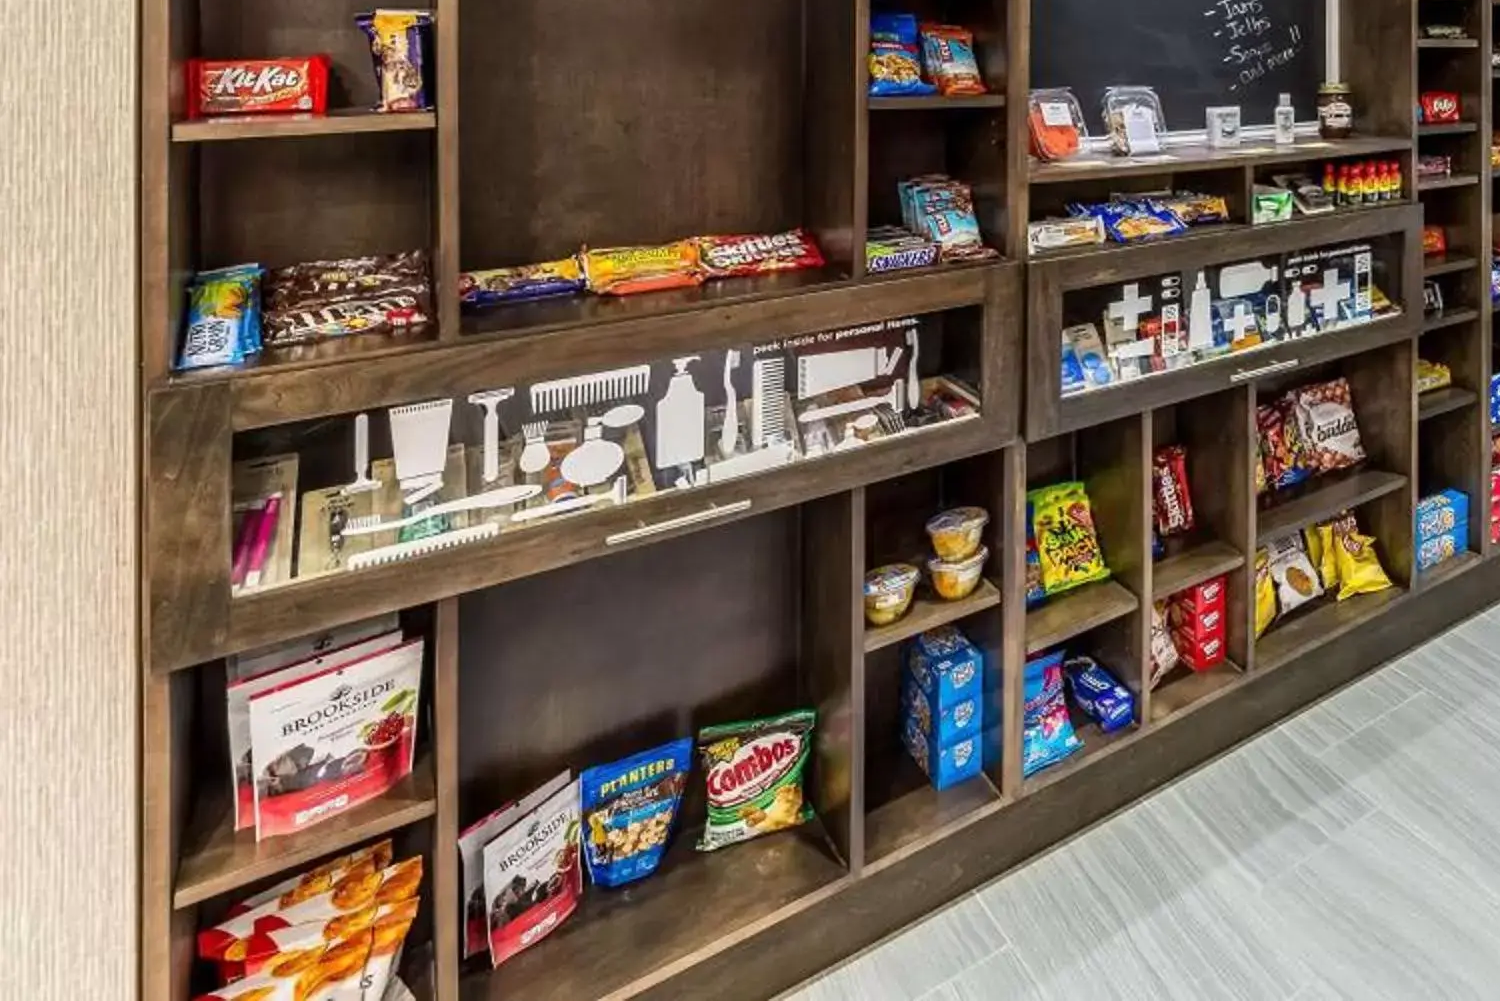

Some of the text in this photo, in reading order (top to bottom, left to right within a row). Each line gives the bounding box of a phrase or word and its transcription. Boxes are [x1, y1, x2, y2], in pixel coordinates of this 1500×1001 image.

[753, 342, 780, 355] peek
[783, 336, 815, 347] inside
[817, 332, 834, 342] for
[835, 321, 884, 340] personal
[281, 678, 396, 737] BROOKSIDE
[600, 758, 675, 798] PLANTERS
[706, 738, 795, 796] Combos
[499, 812, 566, 872] BROOKSIDE
